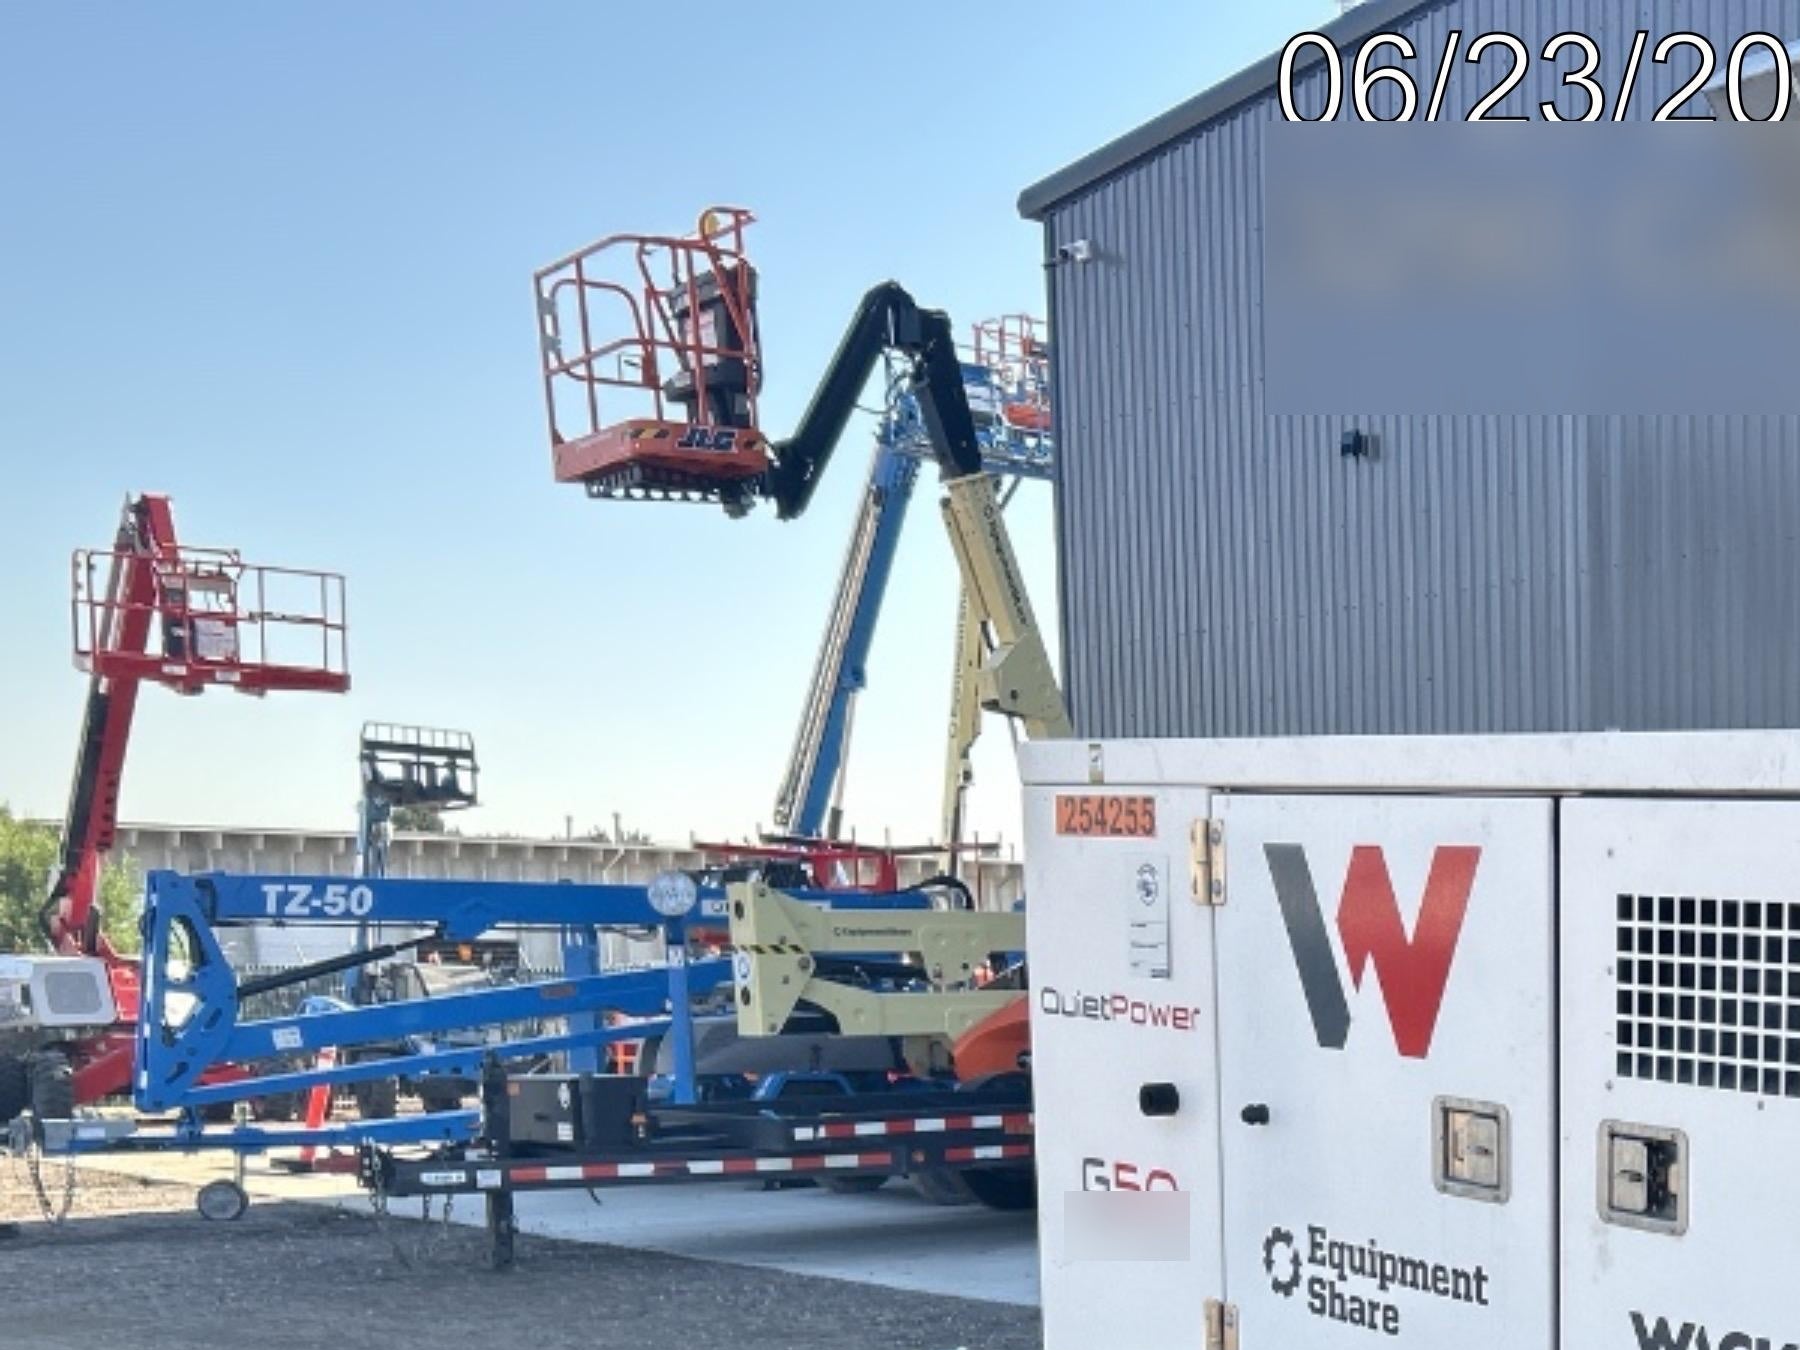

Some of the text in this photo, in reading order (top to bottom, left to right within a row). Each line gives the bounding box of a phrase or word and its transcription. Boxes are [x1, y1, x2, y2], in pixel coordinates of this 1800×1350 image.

[1063, 796, 1155, 835] 254255
[260, 883, 374, 917] TZ-50
[1041, 985, 1202, 1030] QuietPower
[1307, 1223, 1489, 1306] Equipment
[1307, 1275, 1399, 1335] Share
